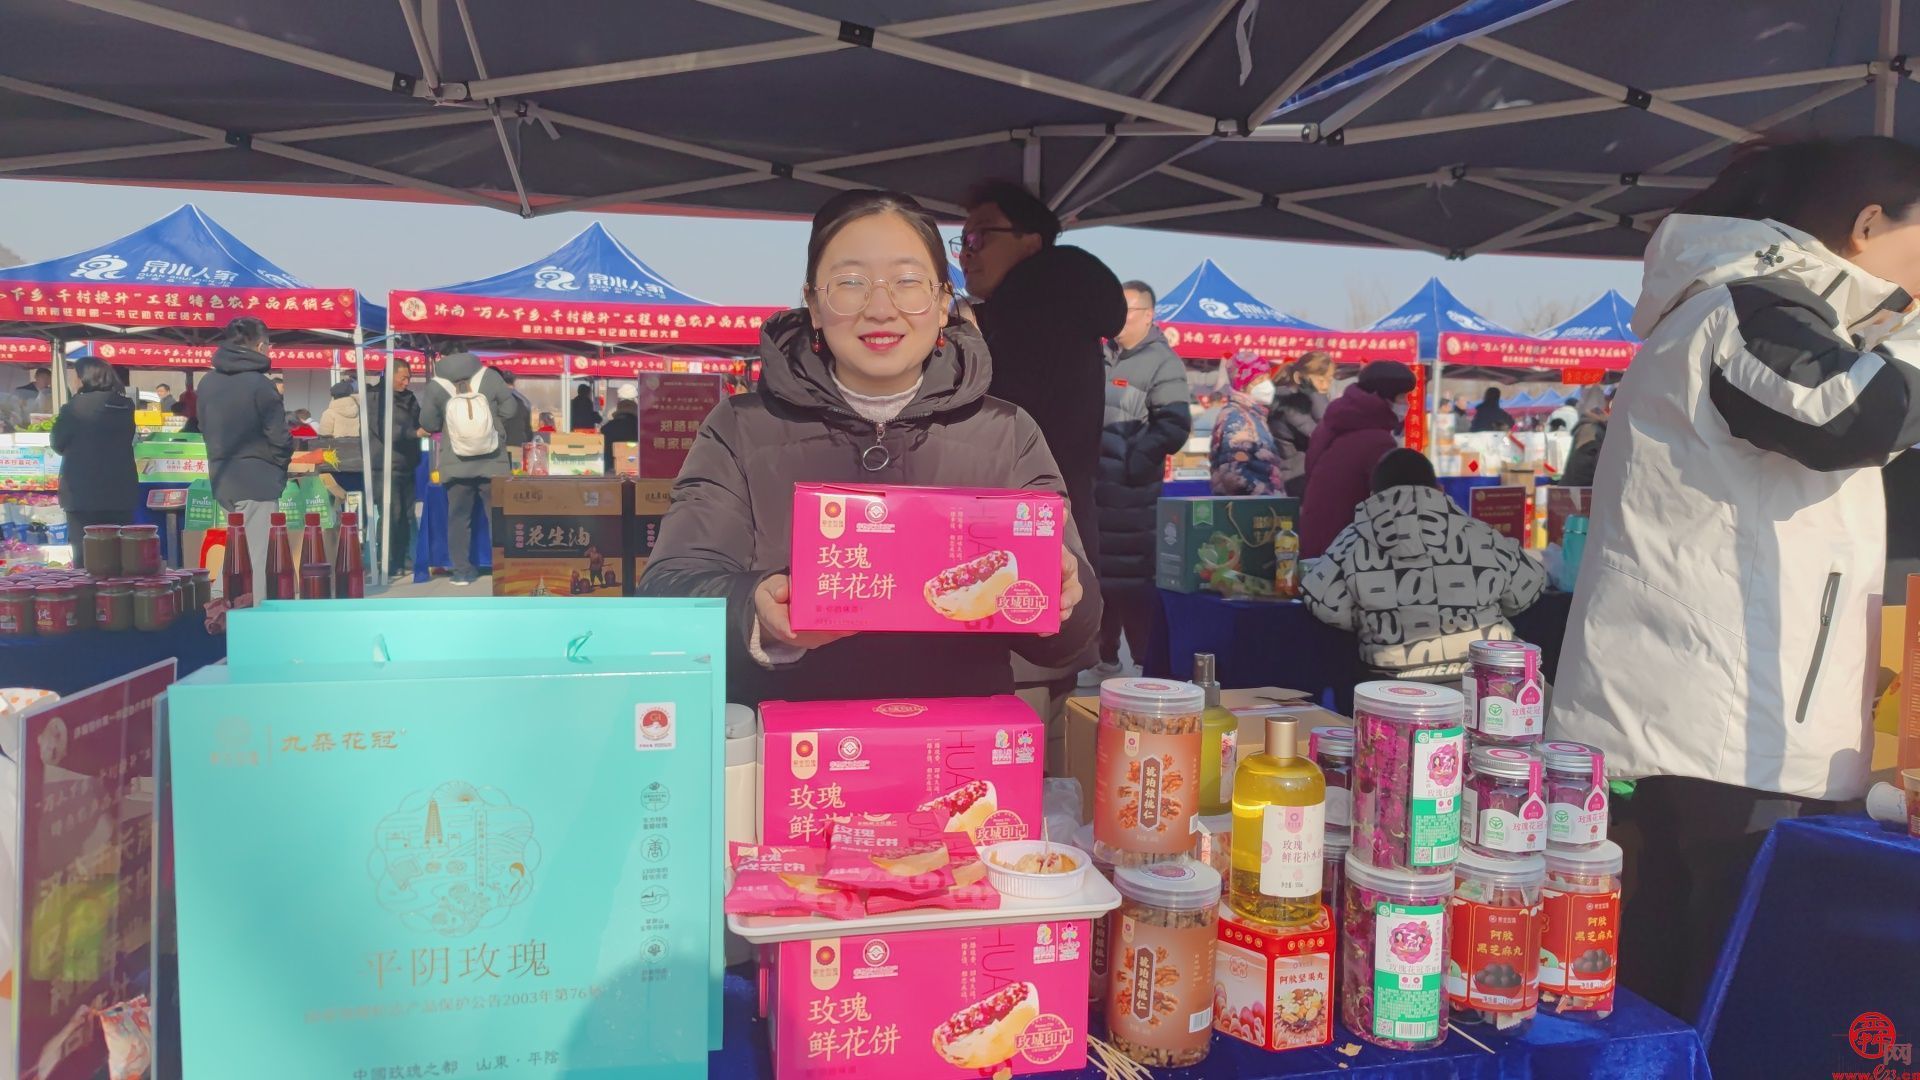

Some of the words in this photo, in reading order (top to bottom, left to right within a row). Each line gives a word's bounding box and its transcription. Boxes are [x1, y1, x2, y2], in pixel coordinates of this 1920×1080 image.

[140, 260, 239, 283] 泉水人家
[588, 272, 665, 295] 泉水人家
[189, 294, 336, 311] 特色农产品展销会
[434, 303, 465, 317] 济南
[525, 524, 591, 548] 花生油
[817, 543, 872, 569] 玫瑰
[816, 572, 897, 601] 鲜花饼
[281, 730, 400, 752] 九朵花冠
[788, 782, 847, 811] 玫瑰
[1142, 765, 1158, 820] 琥珀核桃仁
[1282, 839, 1304, 851] 玫瑰
[1588, 915, 1608, 927] 阿胶
[1490, 929, 1514, 942] 阿胶
[1575, 929, 1613, 942] 黑芝麻丸
[1476, 942, 1524, 957] 黑芝麻丸
[360, 938, 551, 991] 平阴玫瑰
[1135, 955, 1151, 1010] 琥珀核桃仁
[1279, 971, 1326, 985] 阿胶坚果丸
[807, 991, 872, 1025] 玫瑰
[807, 1023, 902, 1063] 鲜花饼
